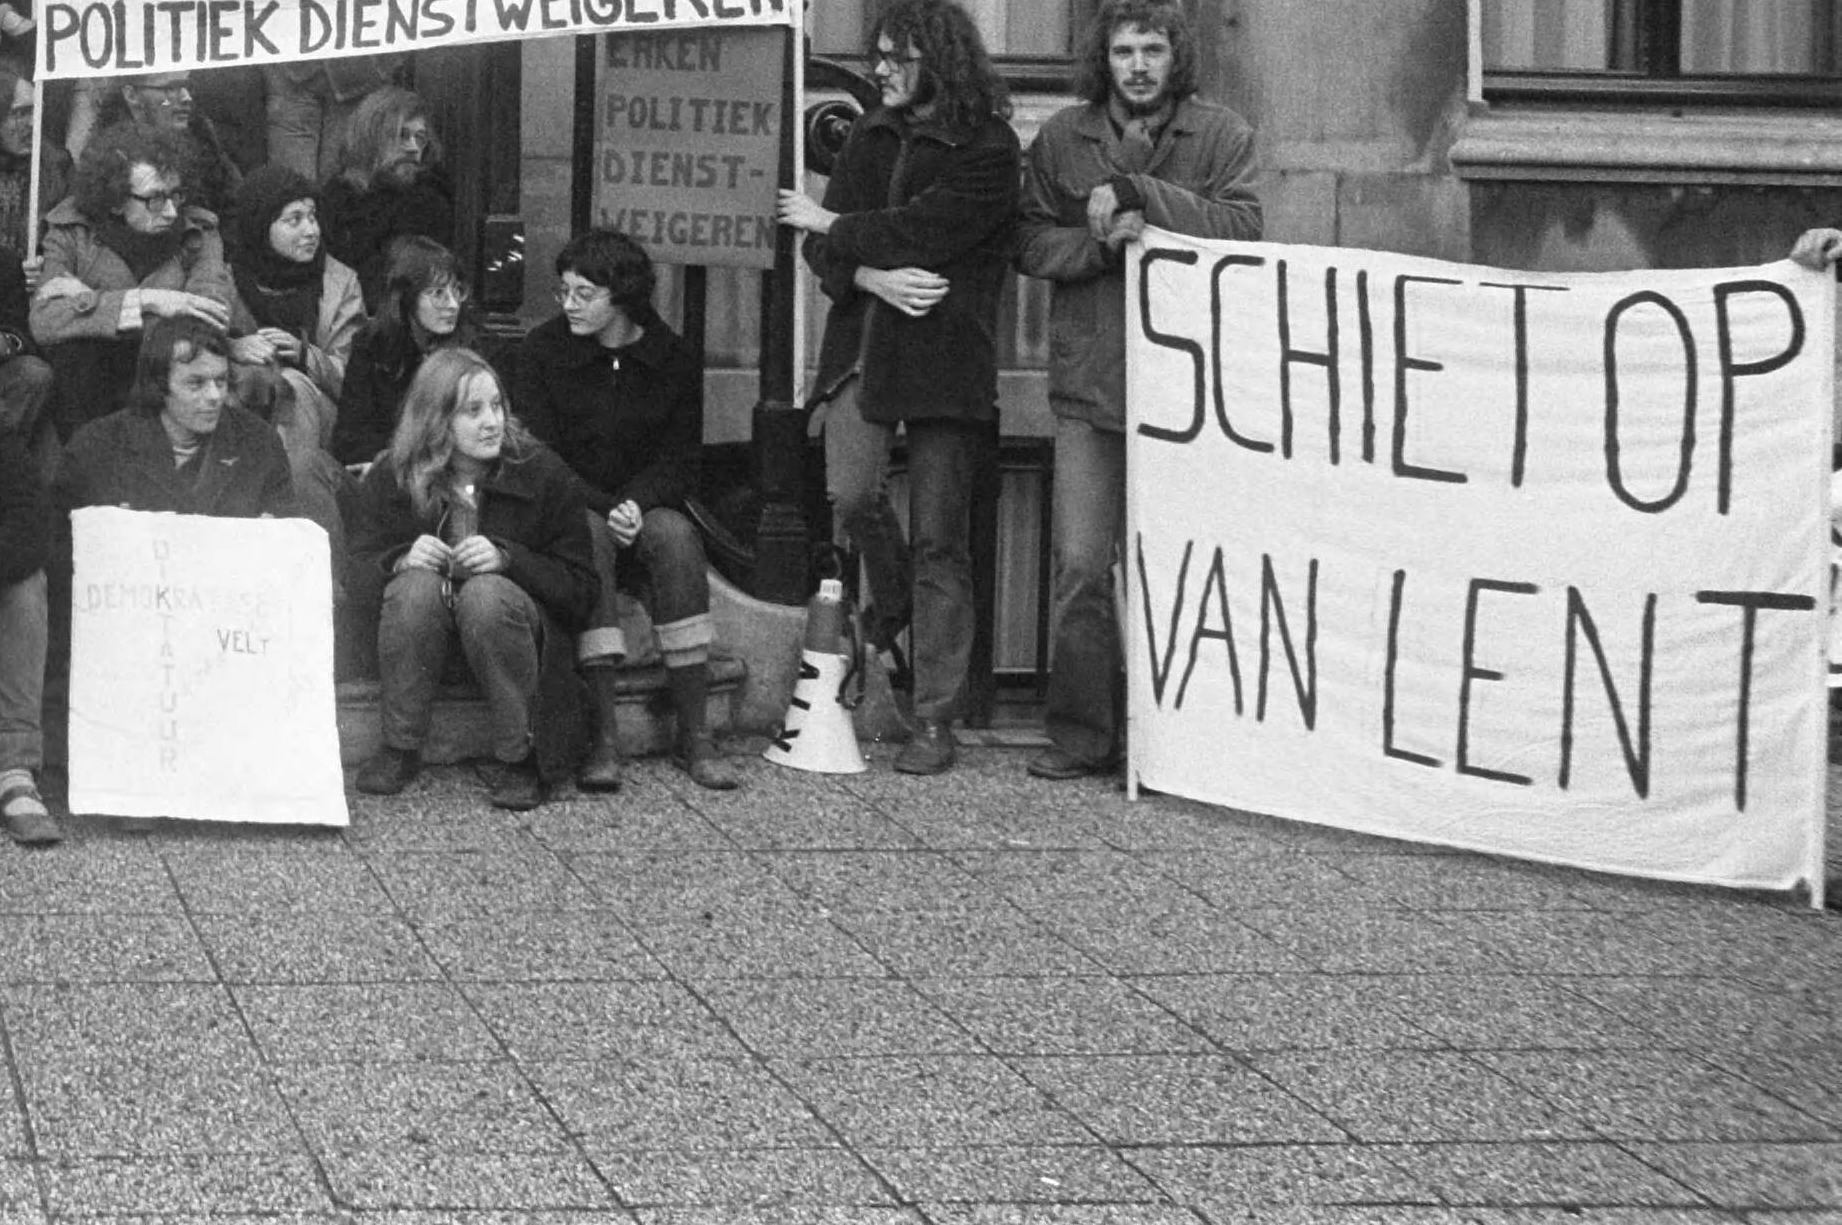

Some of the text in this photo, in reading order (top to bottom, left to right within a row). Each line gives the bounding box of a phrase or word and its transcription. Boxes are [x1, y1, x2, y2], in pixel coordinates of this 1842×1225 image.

[606, 94, 776, 136] POLITIEK
[603, 149, 764, 189] DIENST-
[1137, 247, 1805, 515] SCHIET OP
[216, 629, 271, 655] VELT
[1135, 530, 1318, 731] VAN
[1383, 568, 1816, 813] LENT
